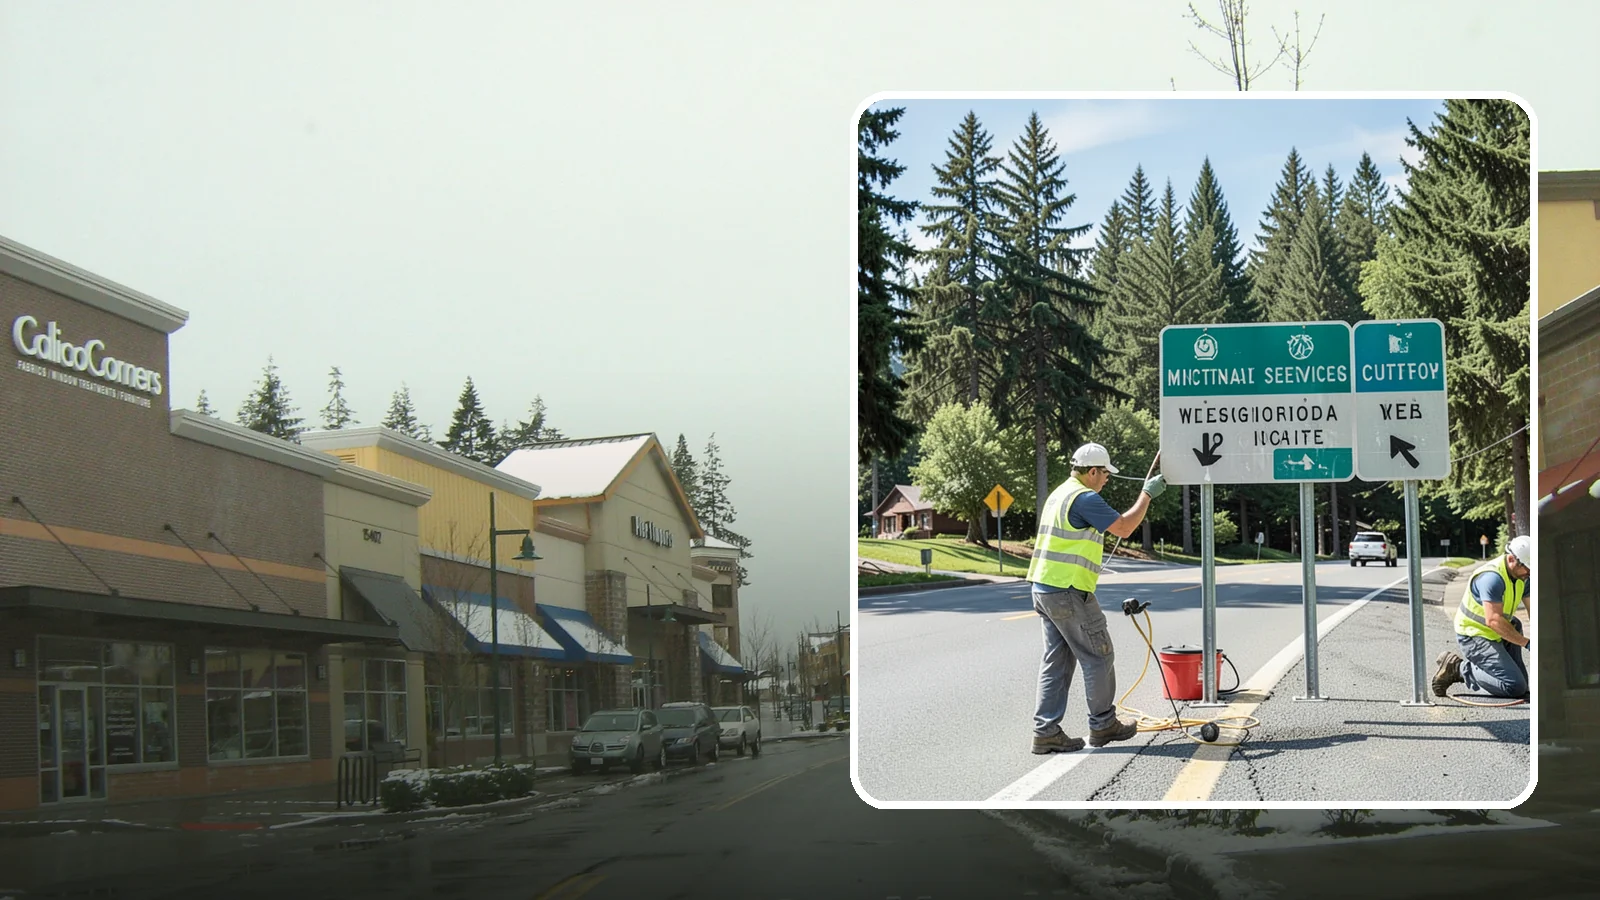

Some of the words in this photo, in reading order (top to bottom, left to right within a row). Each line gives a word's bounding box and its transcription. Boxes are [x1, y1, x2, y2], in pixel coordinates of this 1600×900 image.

[16, 360, 47, 377] FABRICS
[51, 370, 78, 386] WINDOW
[78, 379, 117, 398] TREATMENTS
